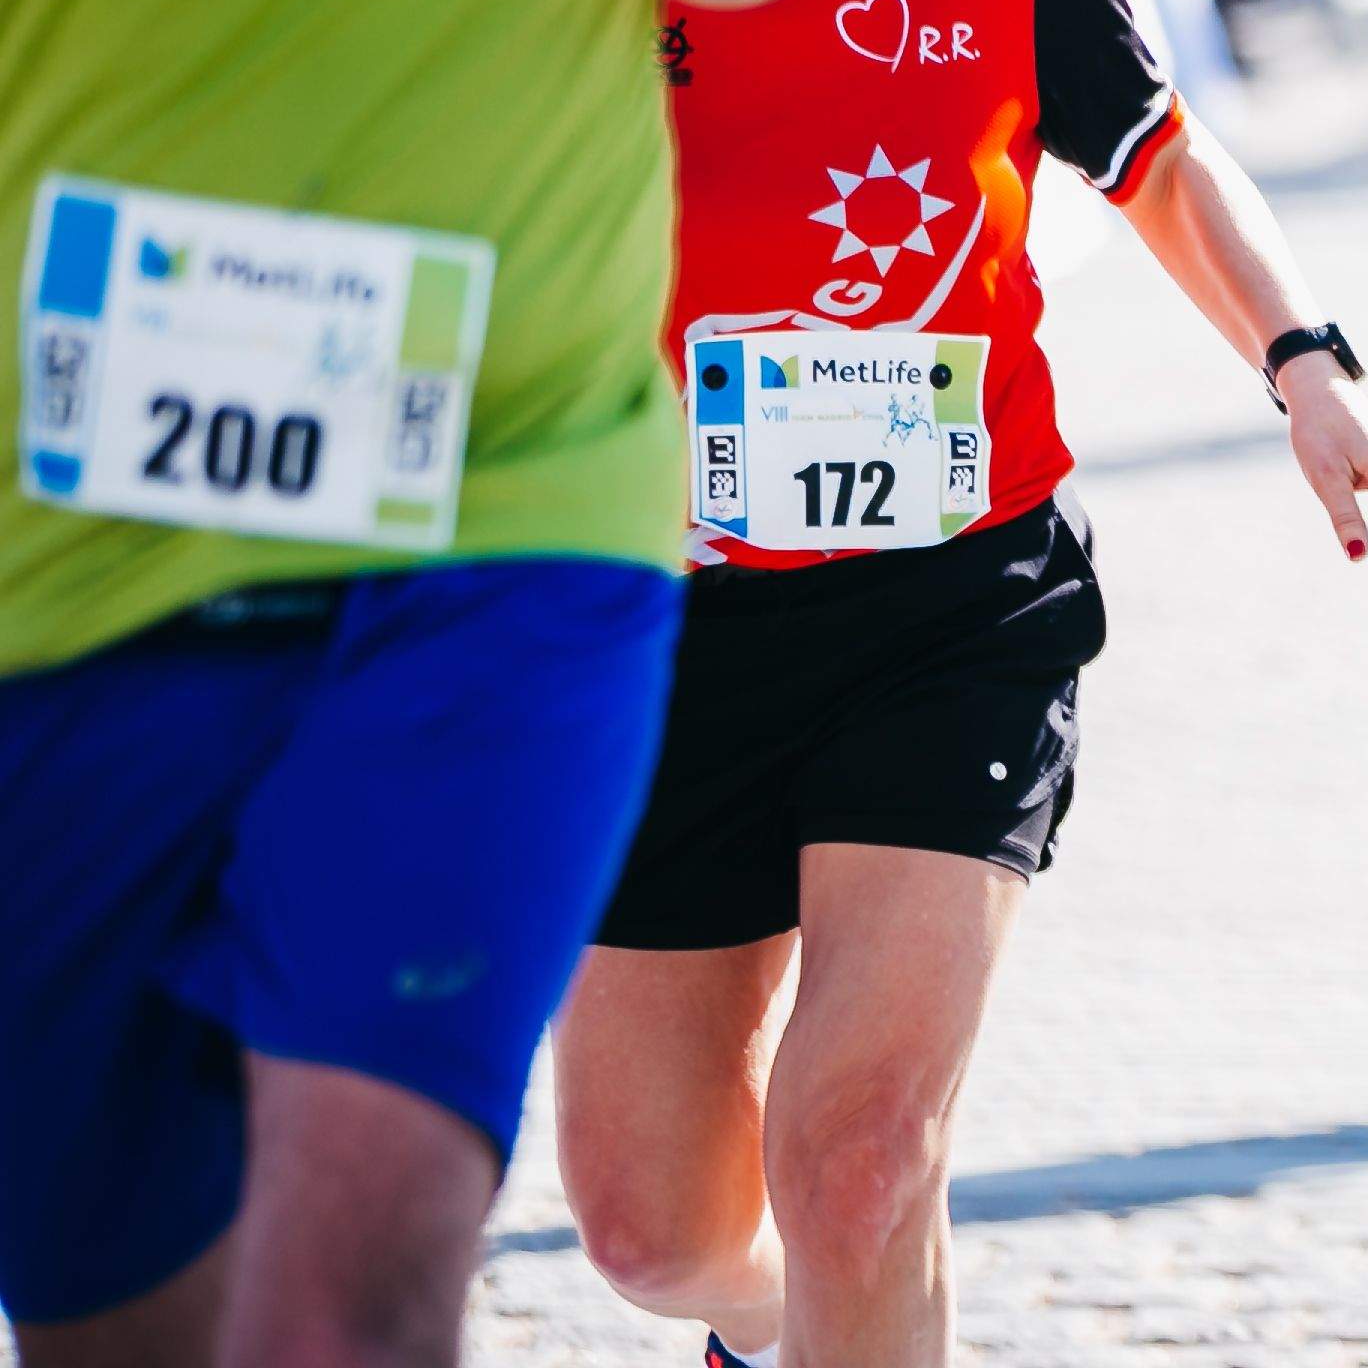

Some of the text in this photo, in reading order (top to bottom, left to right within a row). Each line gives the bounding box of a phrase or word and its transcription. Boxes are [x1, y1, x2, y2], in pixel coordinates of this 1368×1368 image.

[812, 359, 923, 385] MetLife
[141, 392, 325, 496] 200
[793, 460, 897, 527] 172
